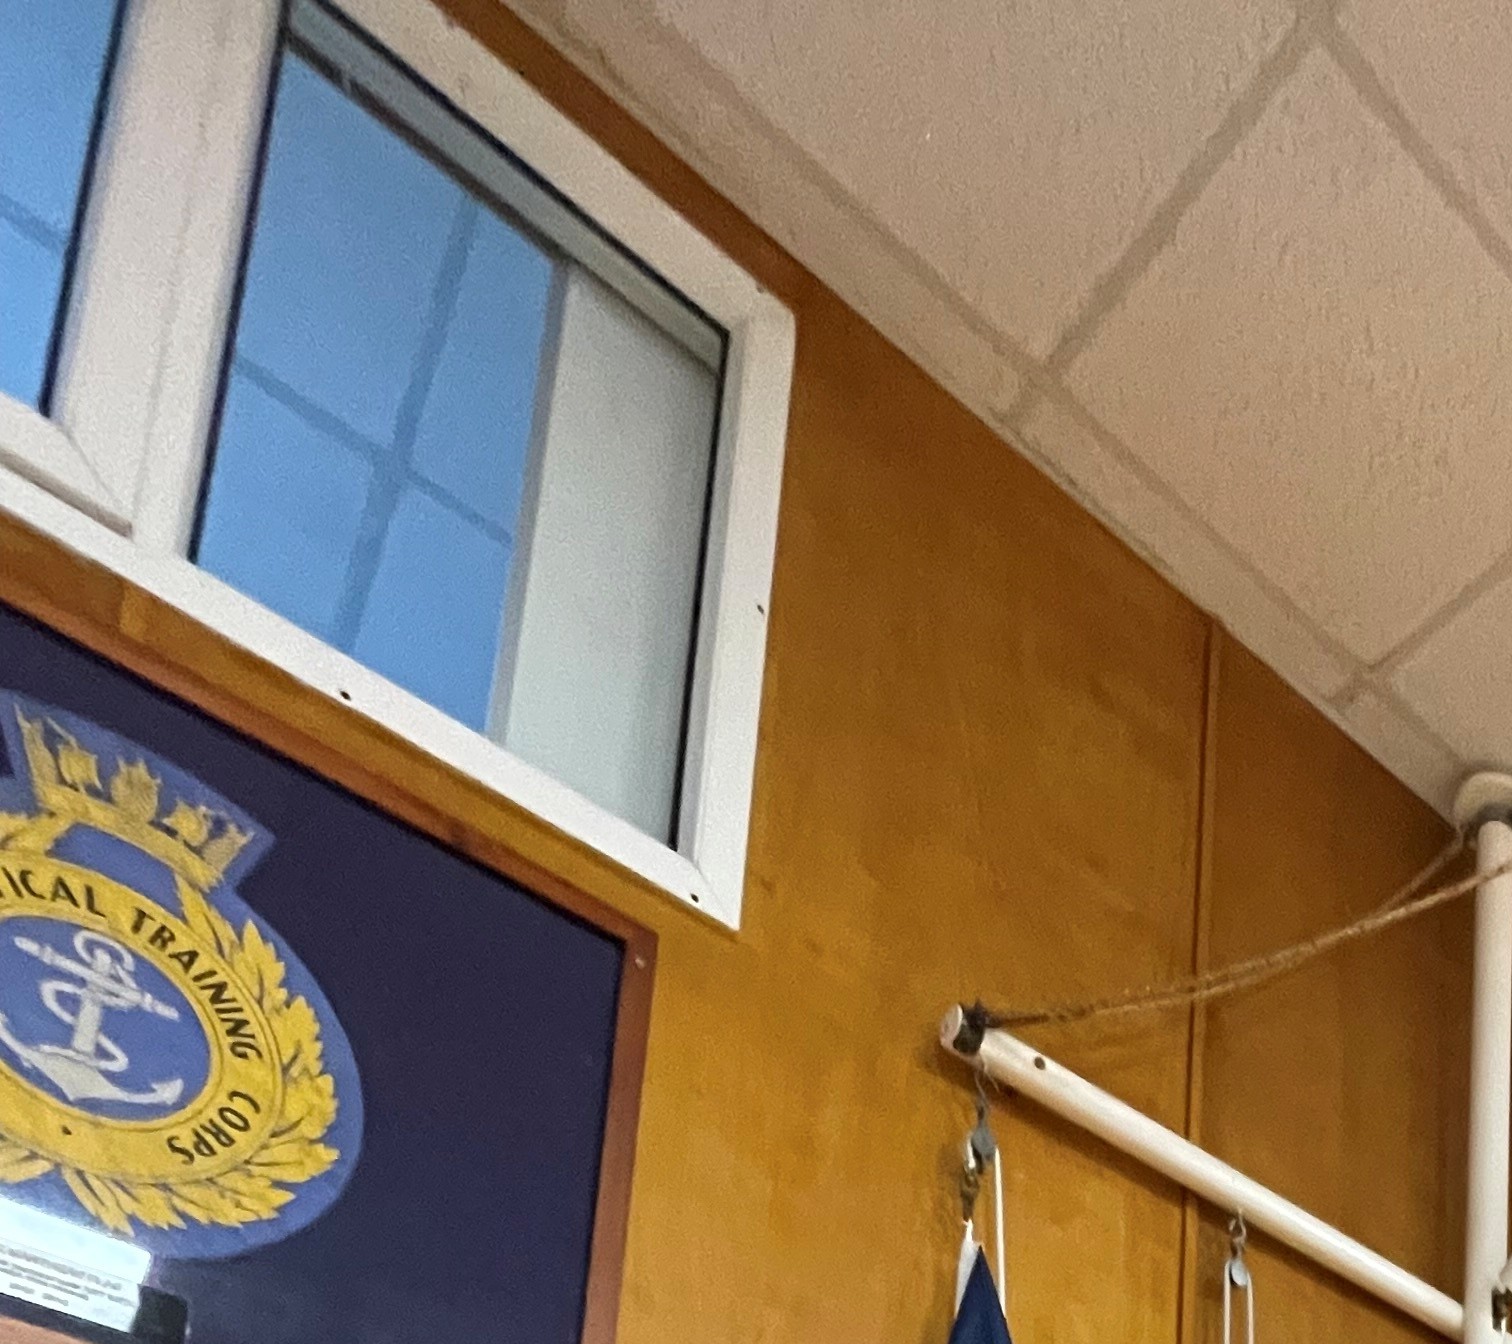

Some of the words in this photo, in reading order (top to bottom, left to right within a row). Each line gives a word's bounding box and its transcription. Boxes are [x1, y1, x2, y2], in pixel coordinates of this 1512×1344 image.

[0, 866, 106, 918] ICAL
[129, 906, 263, 1060] TRAINING
[166, 1089, 261, 1165] CORPS
